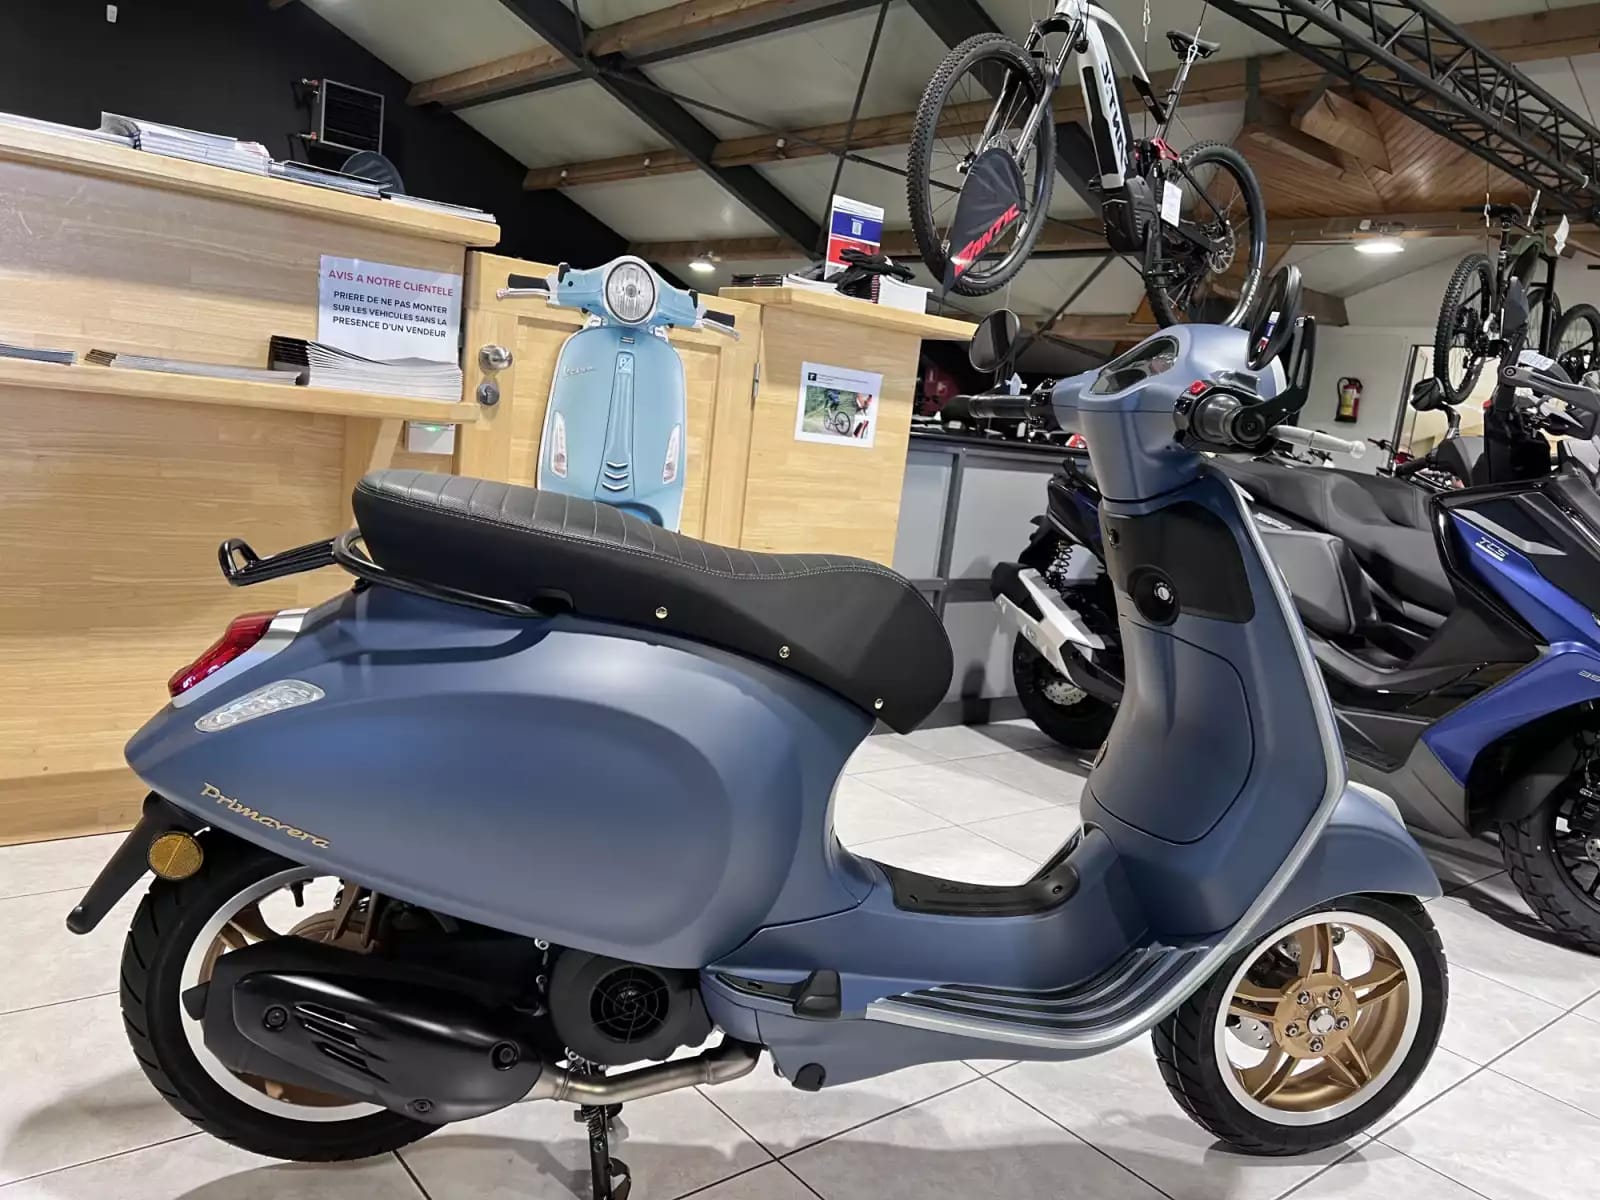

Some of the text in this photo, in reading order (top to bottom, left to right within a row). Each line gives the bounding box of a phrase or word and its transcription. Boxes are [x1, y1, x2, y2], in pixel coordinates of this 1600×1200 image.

[328, 269, 454, 297] AVIS A NOTRE CLIENTELE
[333, 290, 448, 314] PRIERE DE NE PAS MONTER
[333, 303, 351, 313] SUR
[352, 306, 367, 315] LES
[368, 308, 414, 321] VEHICULES
[415, 315, 436, 324] SANS
[332, 316, 447, 338] PRESENCE D'UN VENDEUR
[1479, 537, 1509, 560] TCS
[200, 782, 332, 849] Primavera
